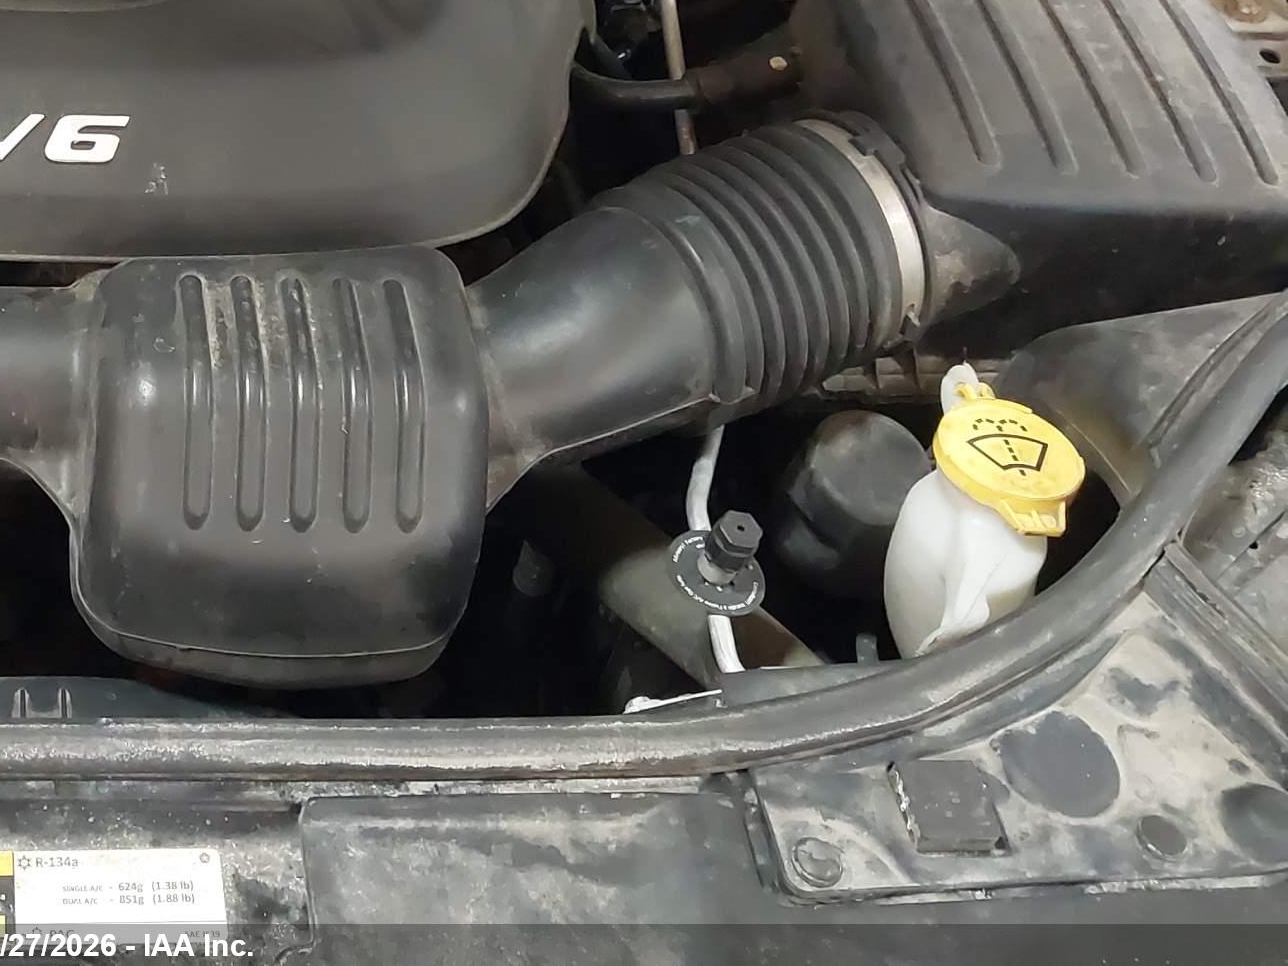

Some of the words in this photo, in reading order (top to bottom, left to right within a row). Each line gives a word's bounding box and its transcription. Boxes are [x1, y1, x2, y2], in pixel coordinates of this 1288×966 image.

[34, 856, 79, 868] R-134a
[90, 884, 103, 892] A/C
[118, 882, 144, 893] 624g
[151, 881, 178, 892] (1.38
[180, 880, 195, 892] lb)
[84, 897, 98, 905] A/C
[119, 894, 145, 906] 851g
[152, 893, 179, 905] (1.88
[181, 893, 196, 905] lb)
